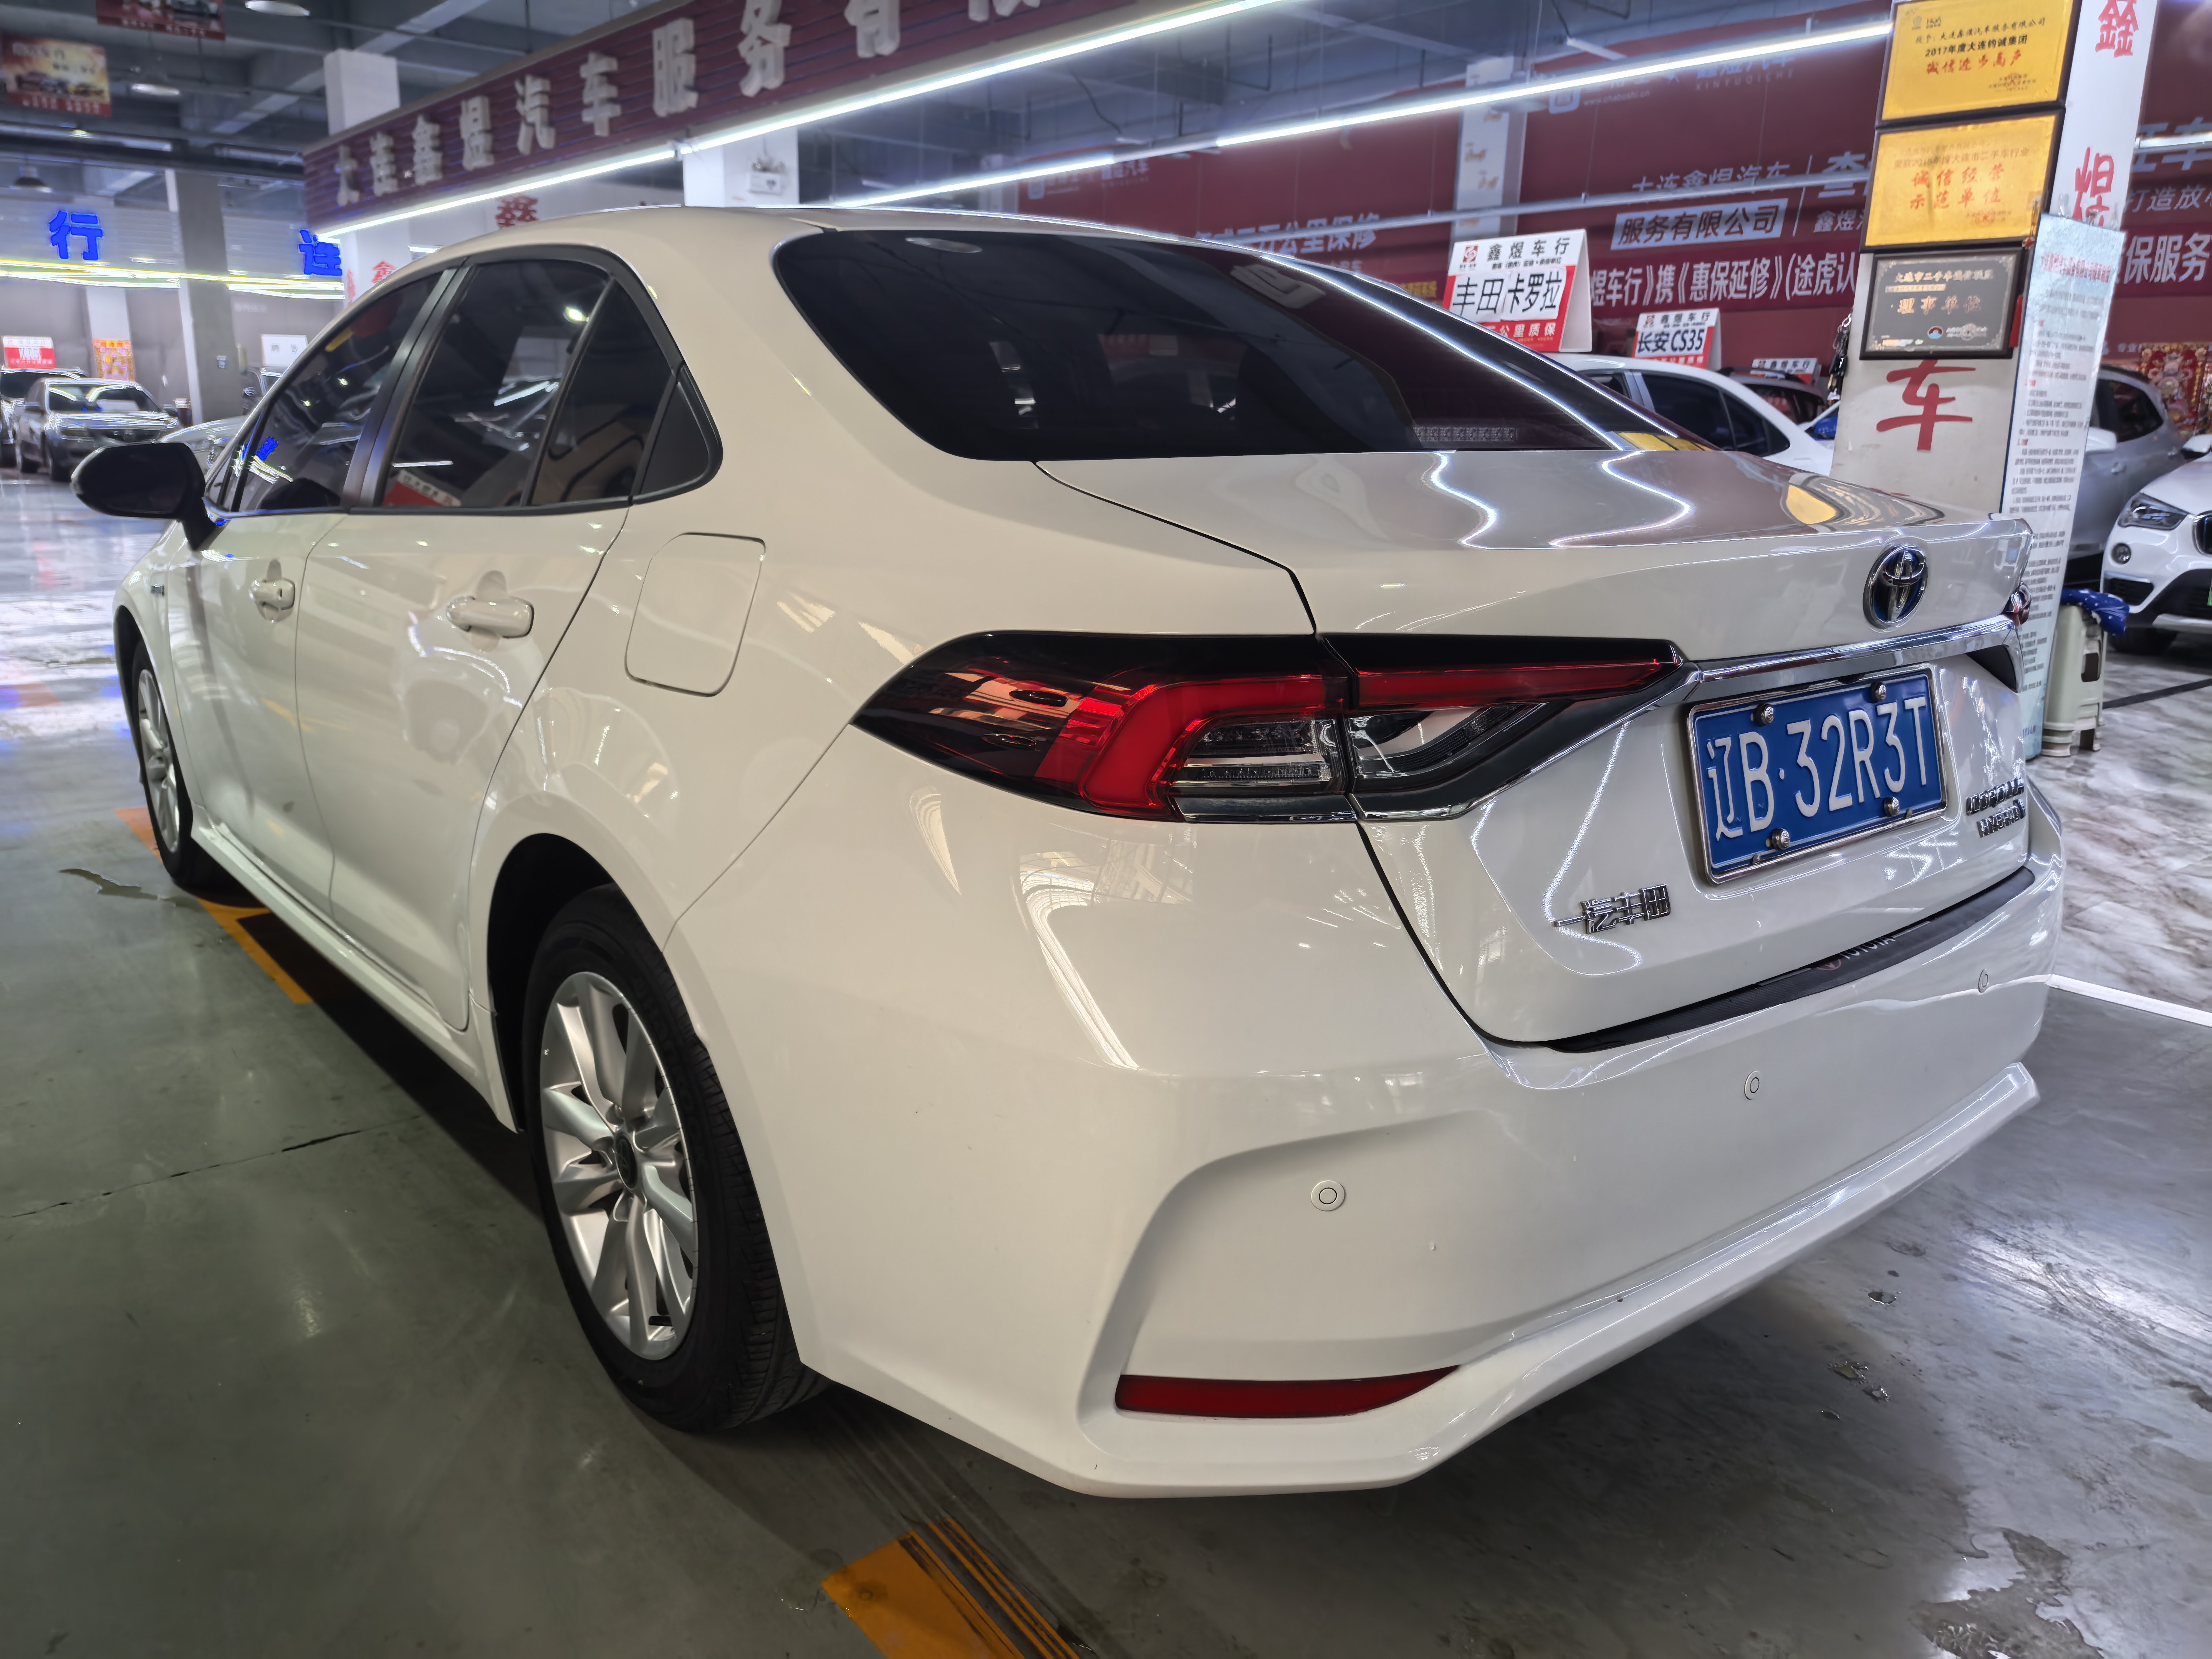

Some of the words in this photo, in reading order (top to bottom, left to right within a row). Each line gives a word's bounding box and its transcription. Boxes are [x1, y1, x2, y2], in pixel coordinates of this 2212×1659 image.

[49, 210, 103, 261] 行
[1618, 204, 1780, 245] 服务有限公司
[1813, 210, 1864, 233] 鑫煜
[1453, 271, 1562, 316] 丰田卡罗拉
[1876, 359, 1976, 452] 车
[1554, 884, 1671, 934] 一汽丰田
